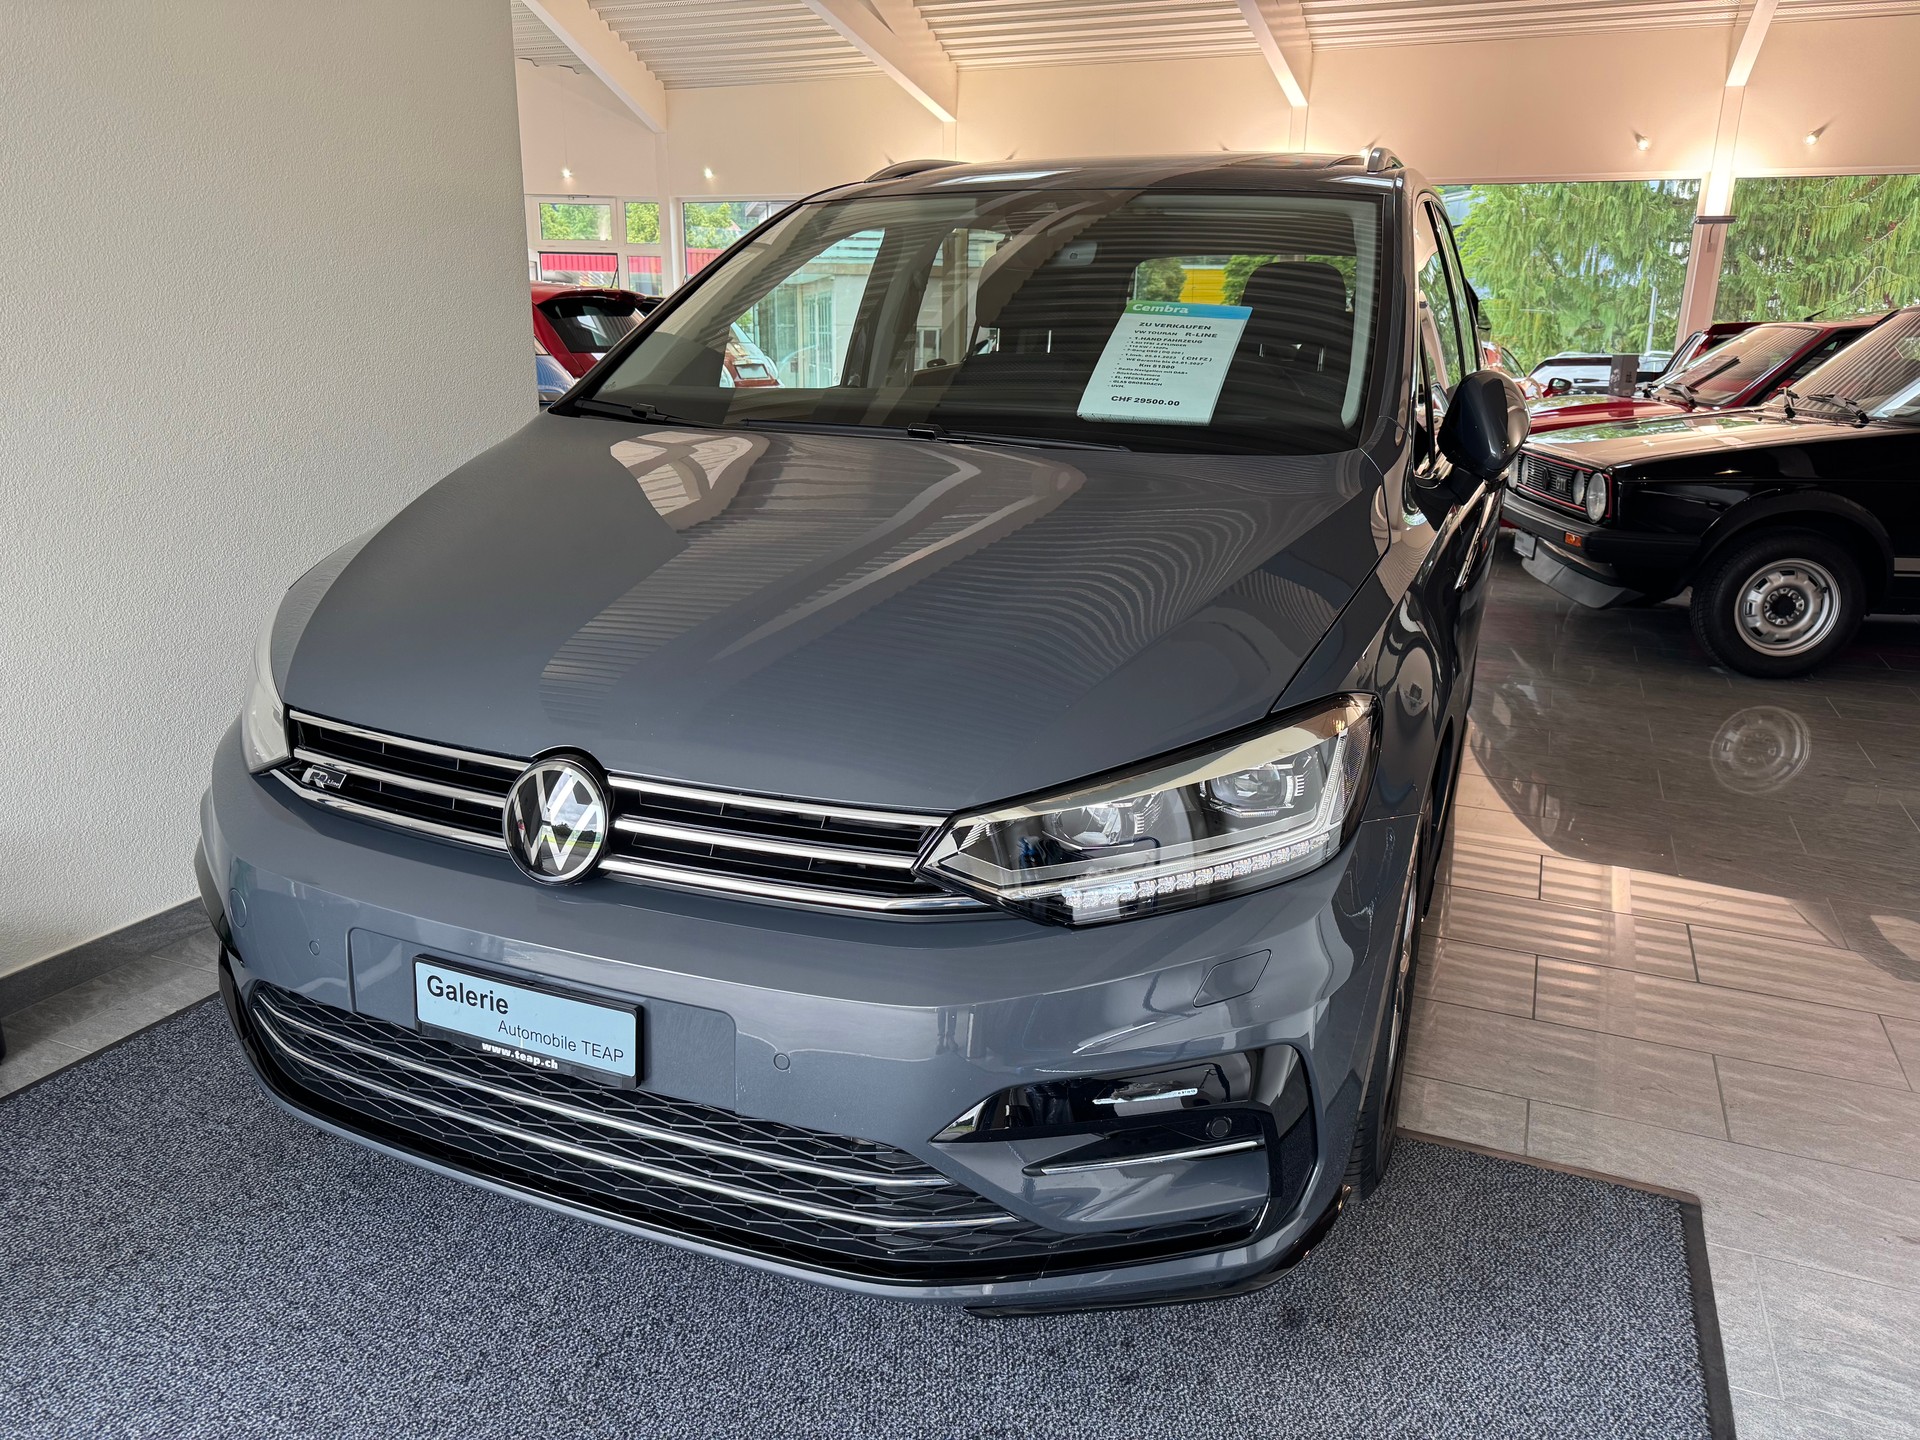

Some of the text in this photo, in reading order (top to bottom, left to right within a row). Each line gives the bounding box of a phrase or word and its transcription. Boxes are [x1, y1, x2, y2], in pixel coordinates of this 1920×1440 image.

[1132, 304, 1189, 314] Cembra
[1154, 322, 1212, 330] VERKAUFEN
[1111, 395, 1180, 407] CHF 29500.00
[426, 974, 509, 1015] Galerie
[498, 1020, 624, 1063] Automobile TEAP
[481, 1042, 559, 1070] www.teap.ch
